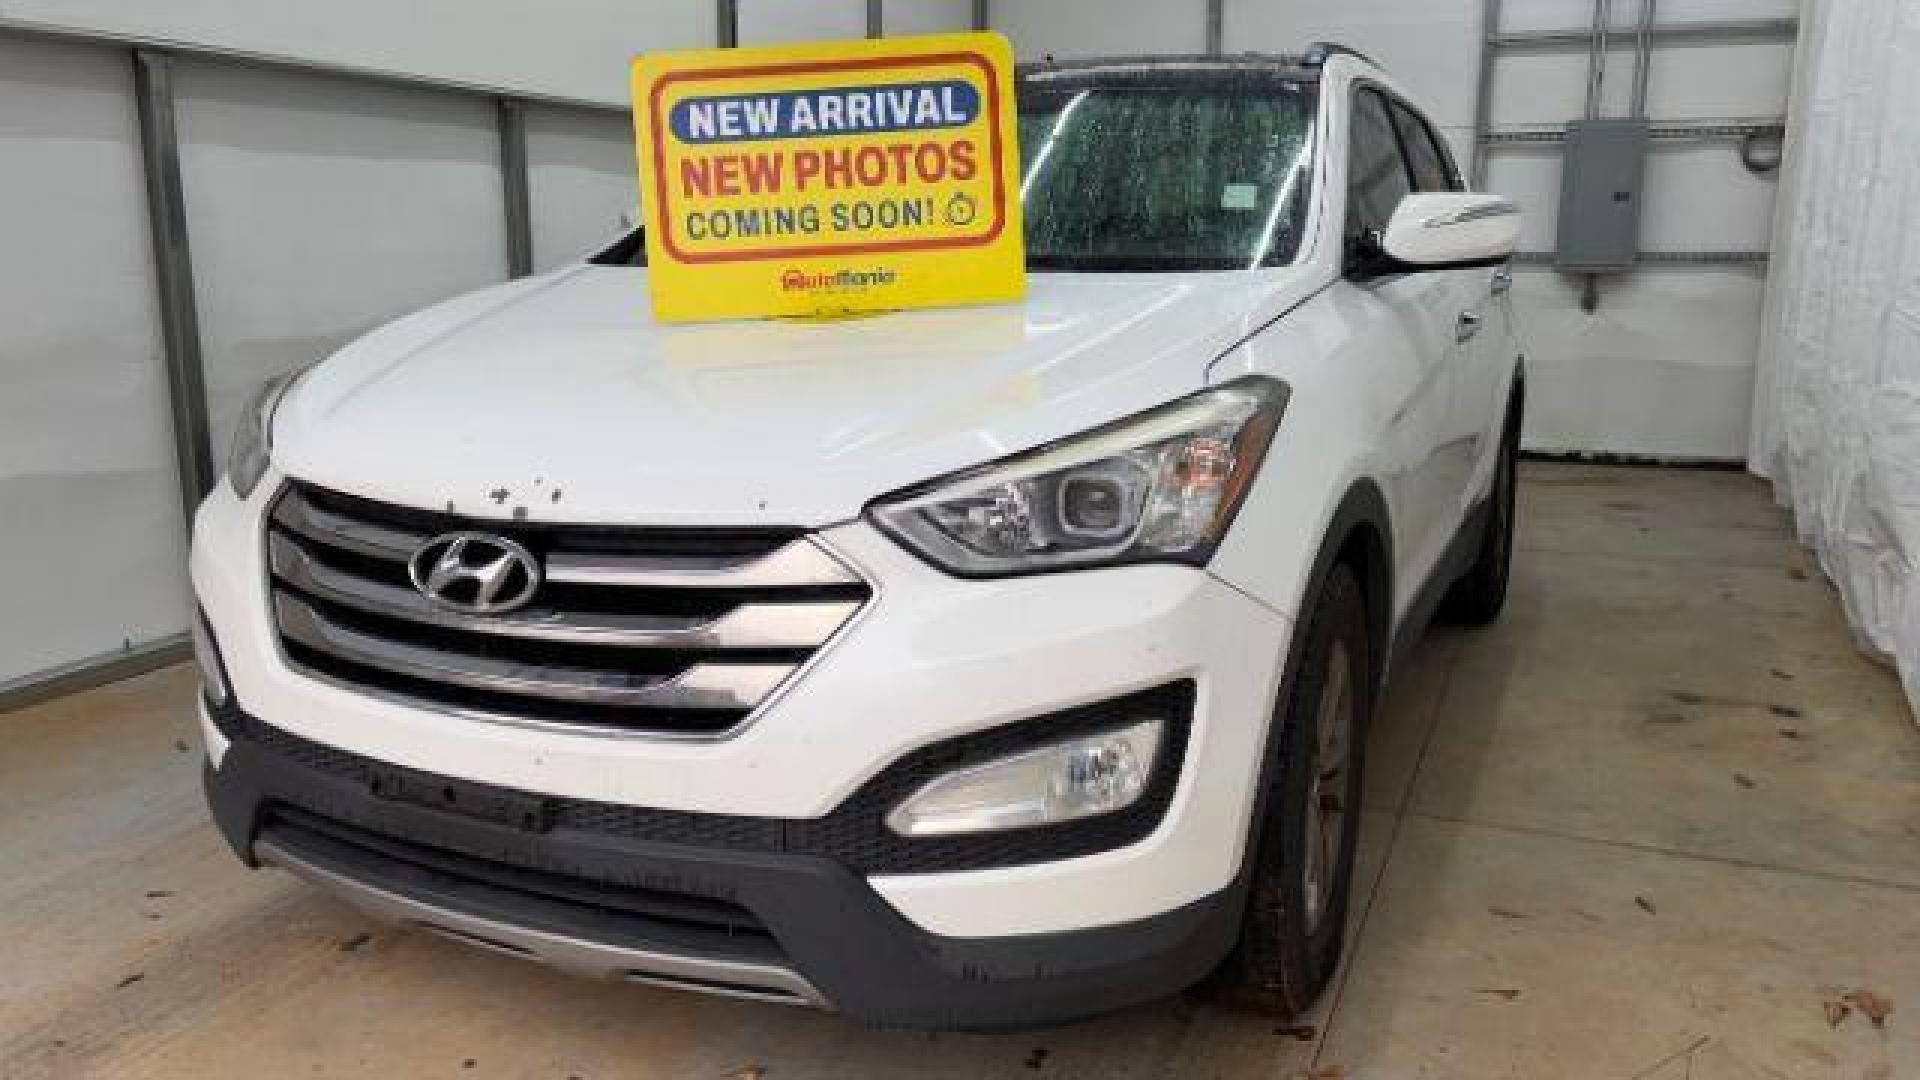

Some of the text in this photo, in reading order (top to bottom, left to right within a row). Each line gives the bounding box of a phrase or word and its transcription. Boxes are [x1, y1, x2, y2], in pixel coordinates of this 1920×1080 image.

[688, 86, 967, 138] NEW ARRIVAL
[680, 140, 977, 198] NEW PHOTOS
[687, 198, 934, 239] COMING SOON!
